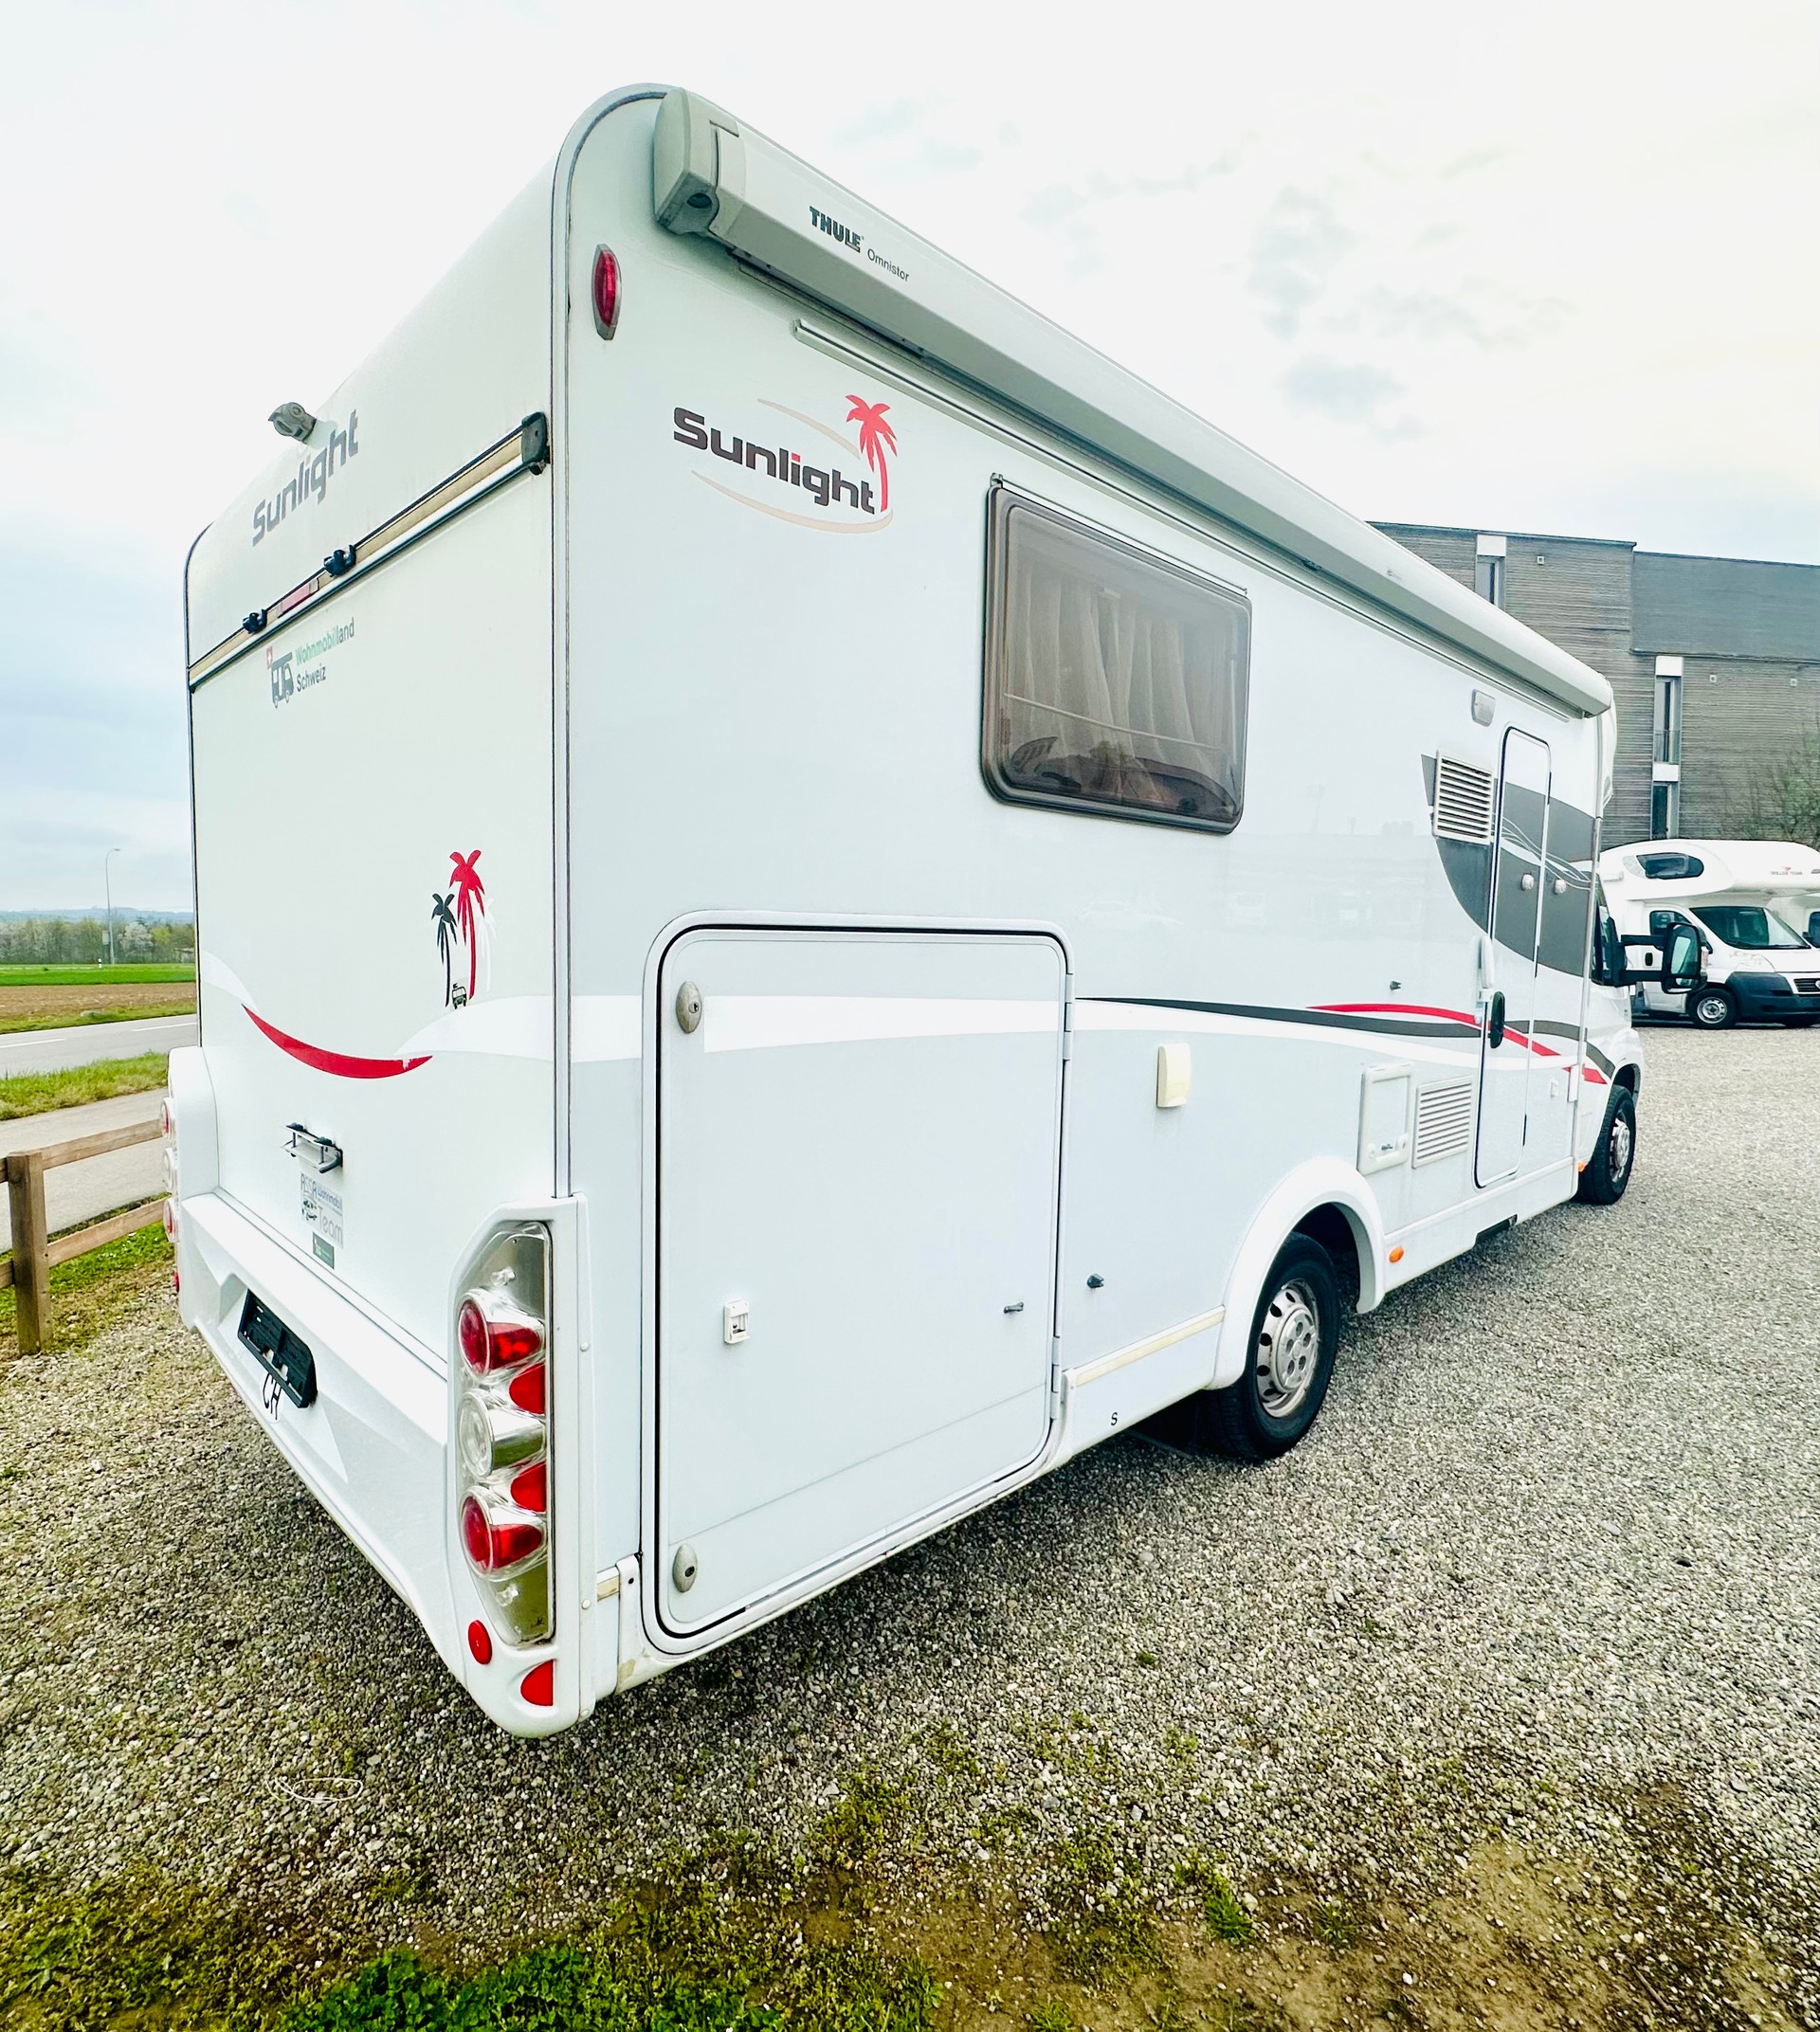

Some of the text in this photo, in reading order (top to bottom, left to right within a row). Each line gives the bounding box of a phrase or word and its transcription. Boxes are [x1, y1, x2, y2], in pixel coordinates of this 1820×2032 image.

[809, 205, 910, 282] THULE Omnistor
[251, 408, 359, 548] Sunlight
[673, 407, 876, 515] Sunlight
[296, 662, 327, 693] Schweiz
[263, 1372, 282, 1421] CH
[1110, 1411, 1119, 1426] S
